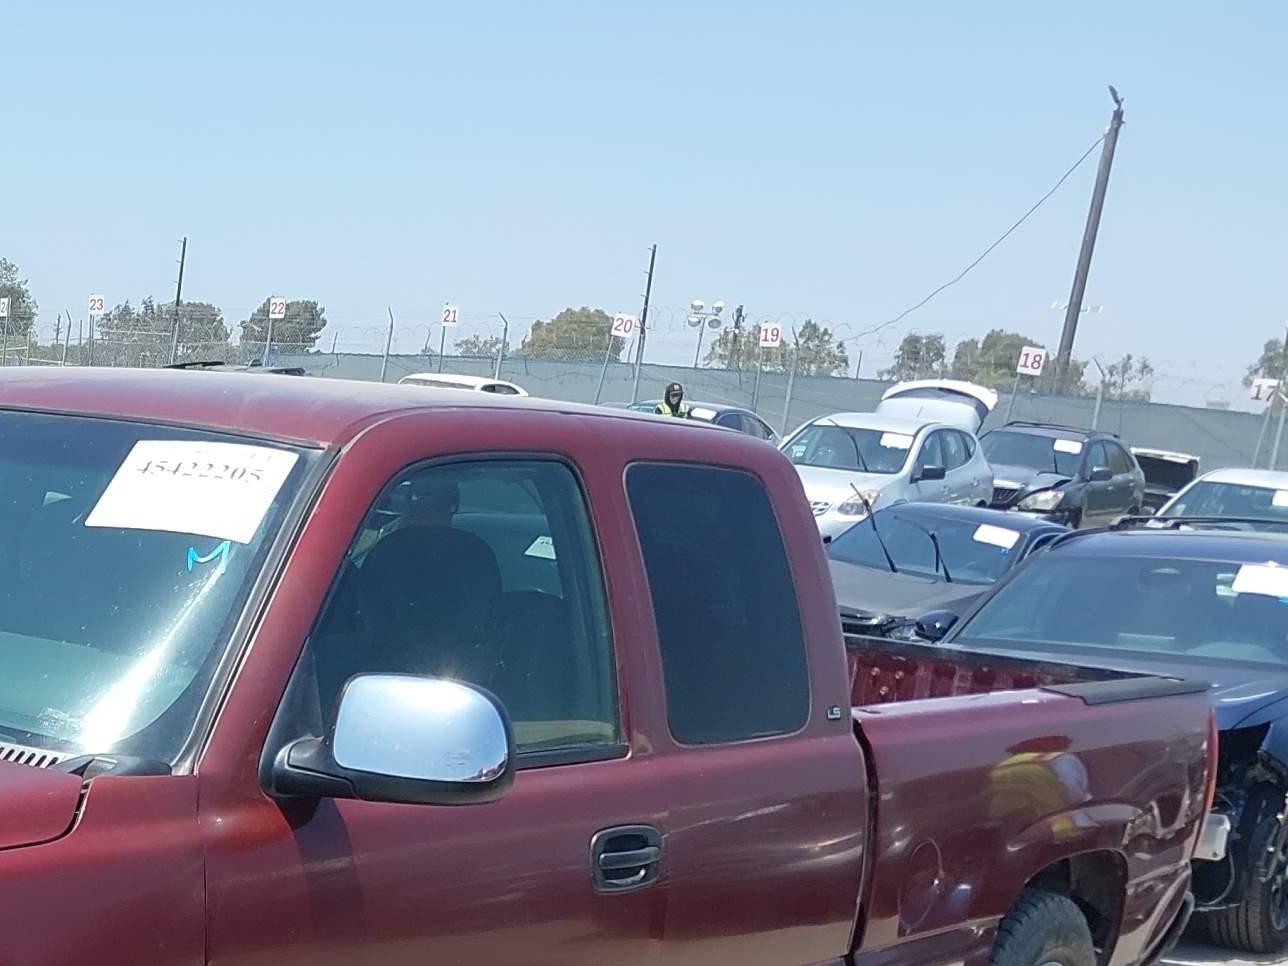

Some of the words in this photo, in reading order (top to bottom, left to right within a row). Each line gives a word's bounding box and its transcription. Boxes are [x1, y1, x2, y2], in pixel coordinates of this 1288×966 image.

[89, 298, 104, 311] 23
[270, 302, 285, 315] 22
[443, 308, 457, 323] 21
[613, 317, 633, 334] 20
[761, 327, 781, 343] 19
[1019, 352, 1043, 370] 18
[1250, 383, 1279, 402] 17
[136, 460, 265, 482] 45422205
